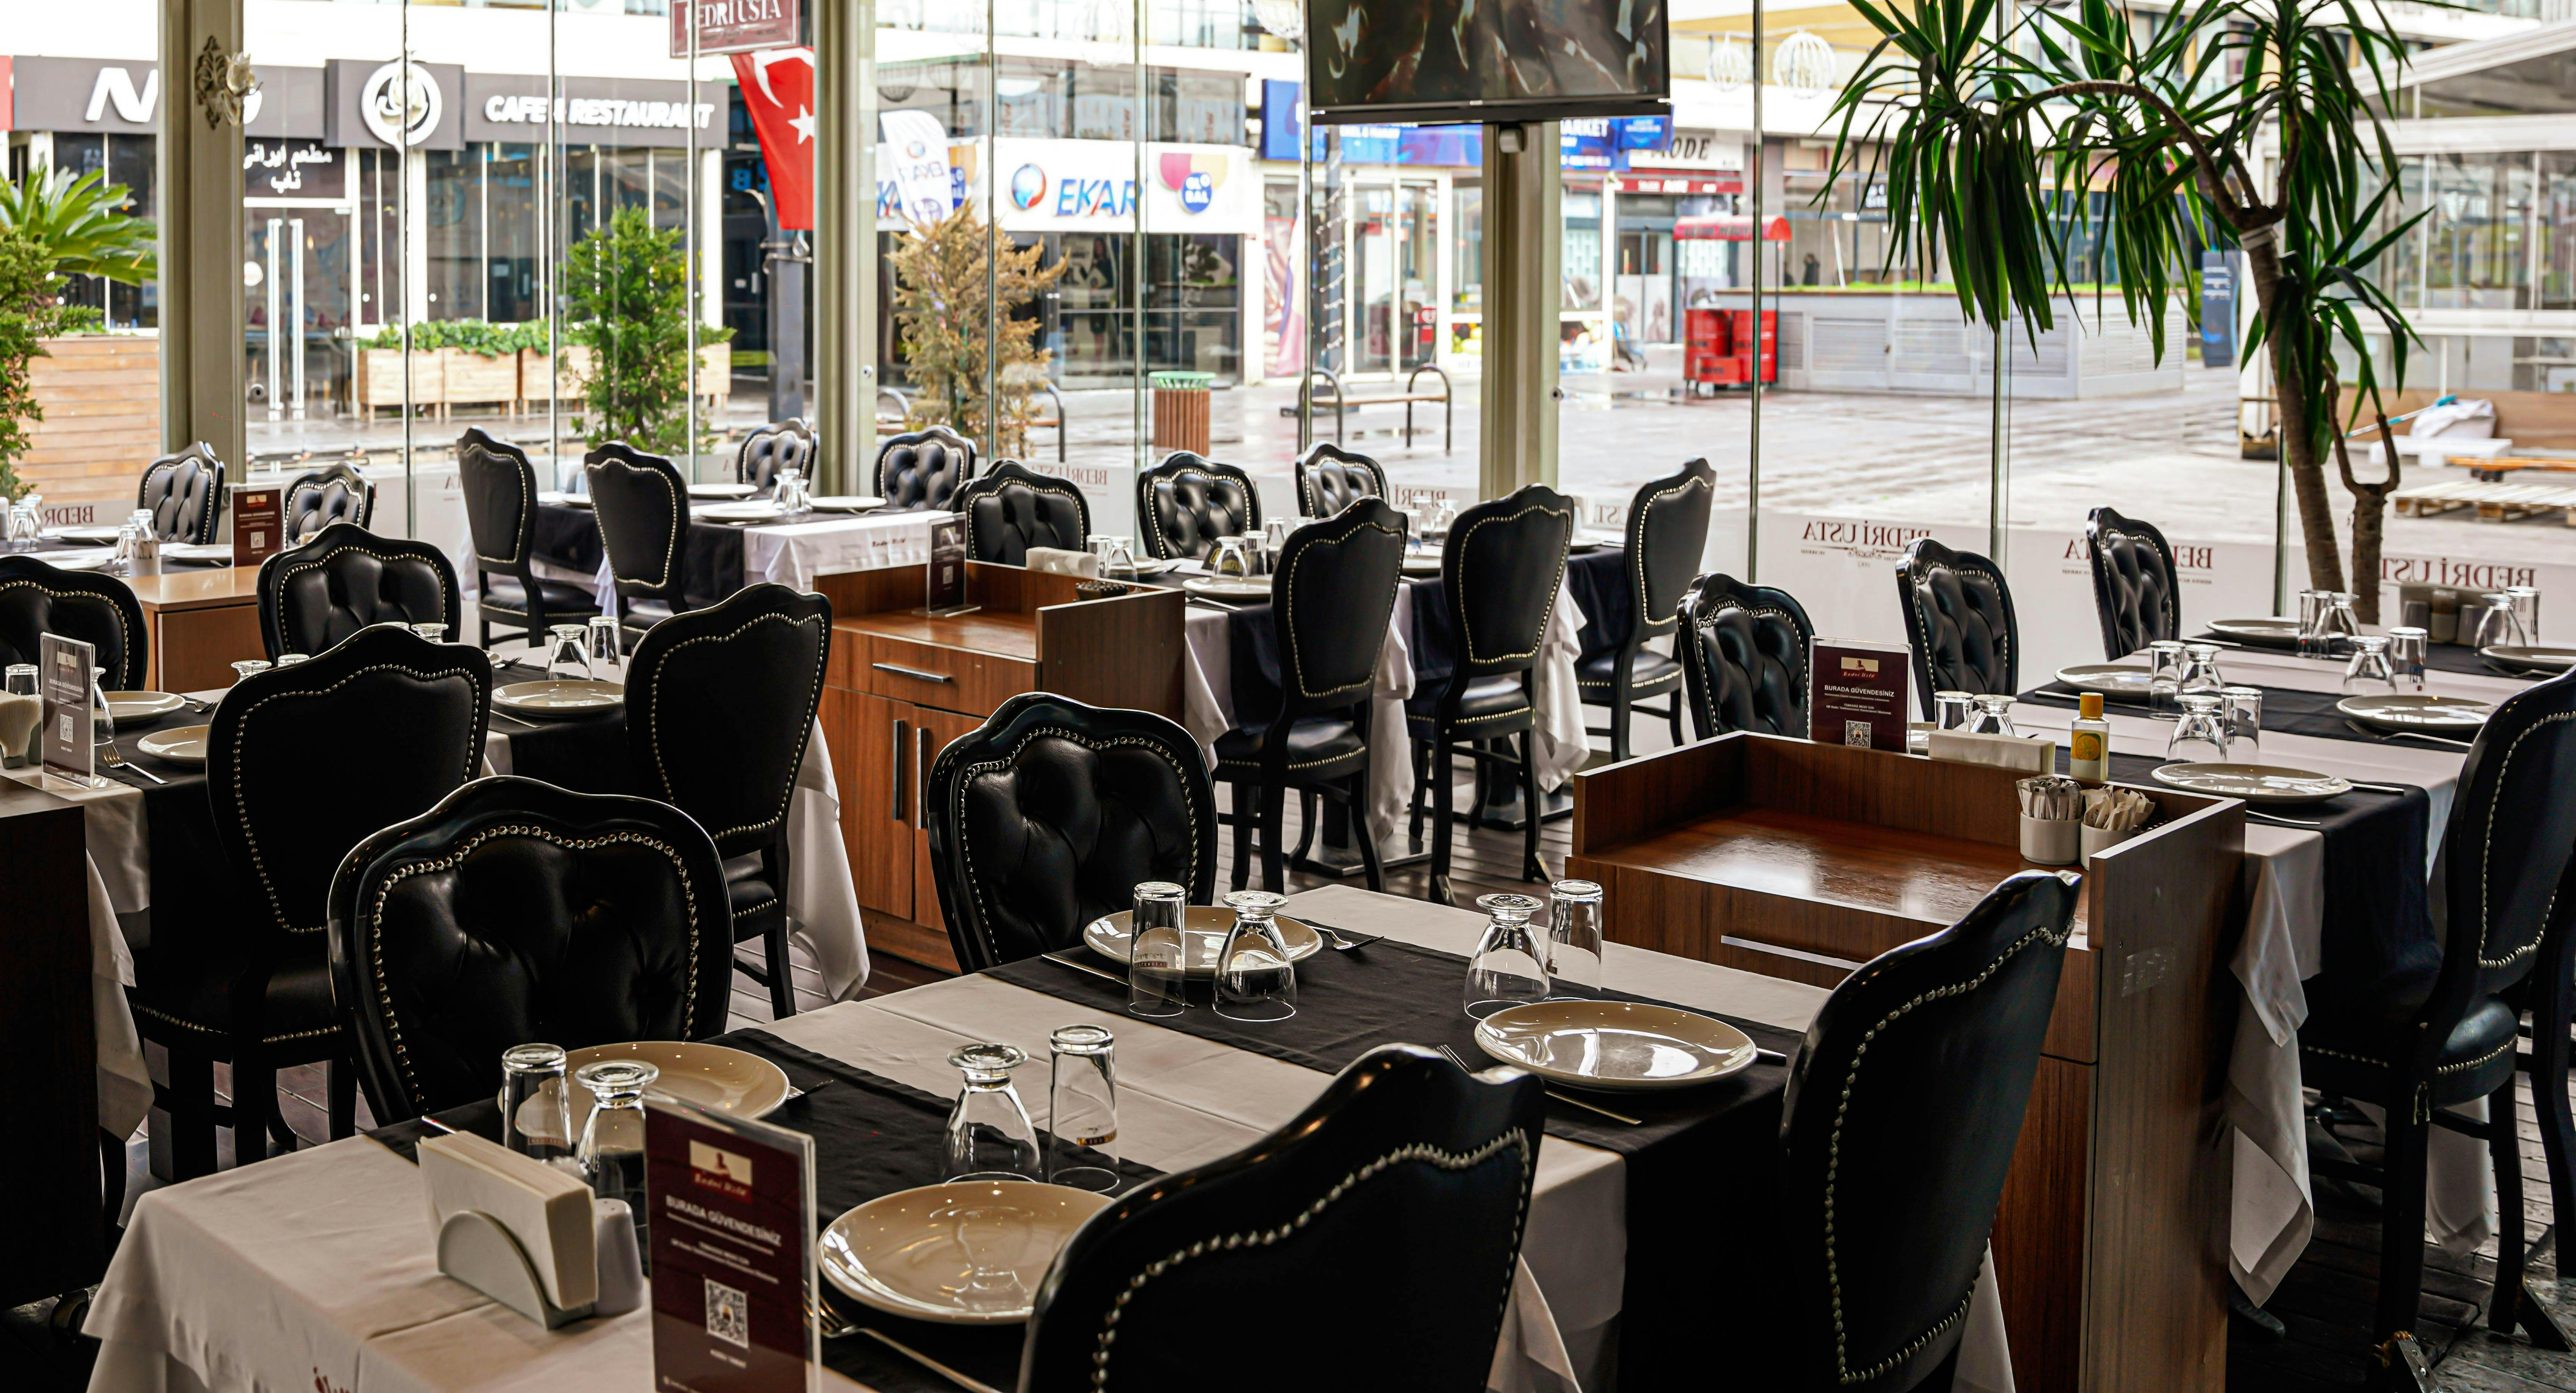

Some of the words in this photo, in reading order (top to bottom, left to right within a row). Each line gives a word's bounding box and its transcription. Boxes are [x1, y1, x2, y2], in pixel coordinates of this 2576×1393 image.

[485, 95, 548, 123] CAFE
[1650, 137, 1710, 159] ODE
[1056, 179, 1143, 217] EKAR
[1850, 687, 1894, 697] GÜVENDESİNİZ
[665, 1194, 707, 1220] BURADA
[707, 1210, 782, 1247] GÜVENDESİNİZ
